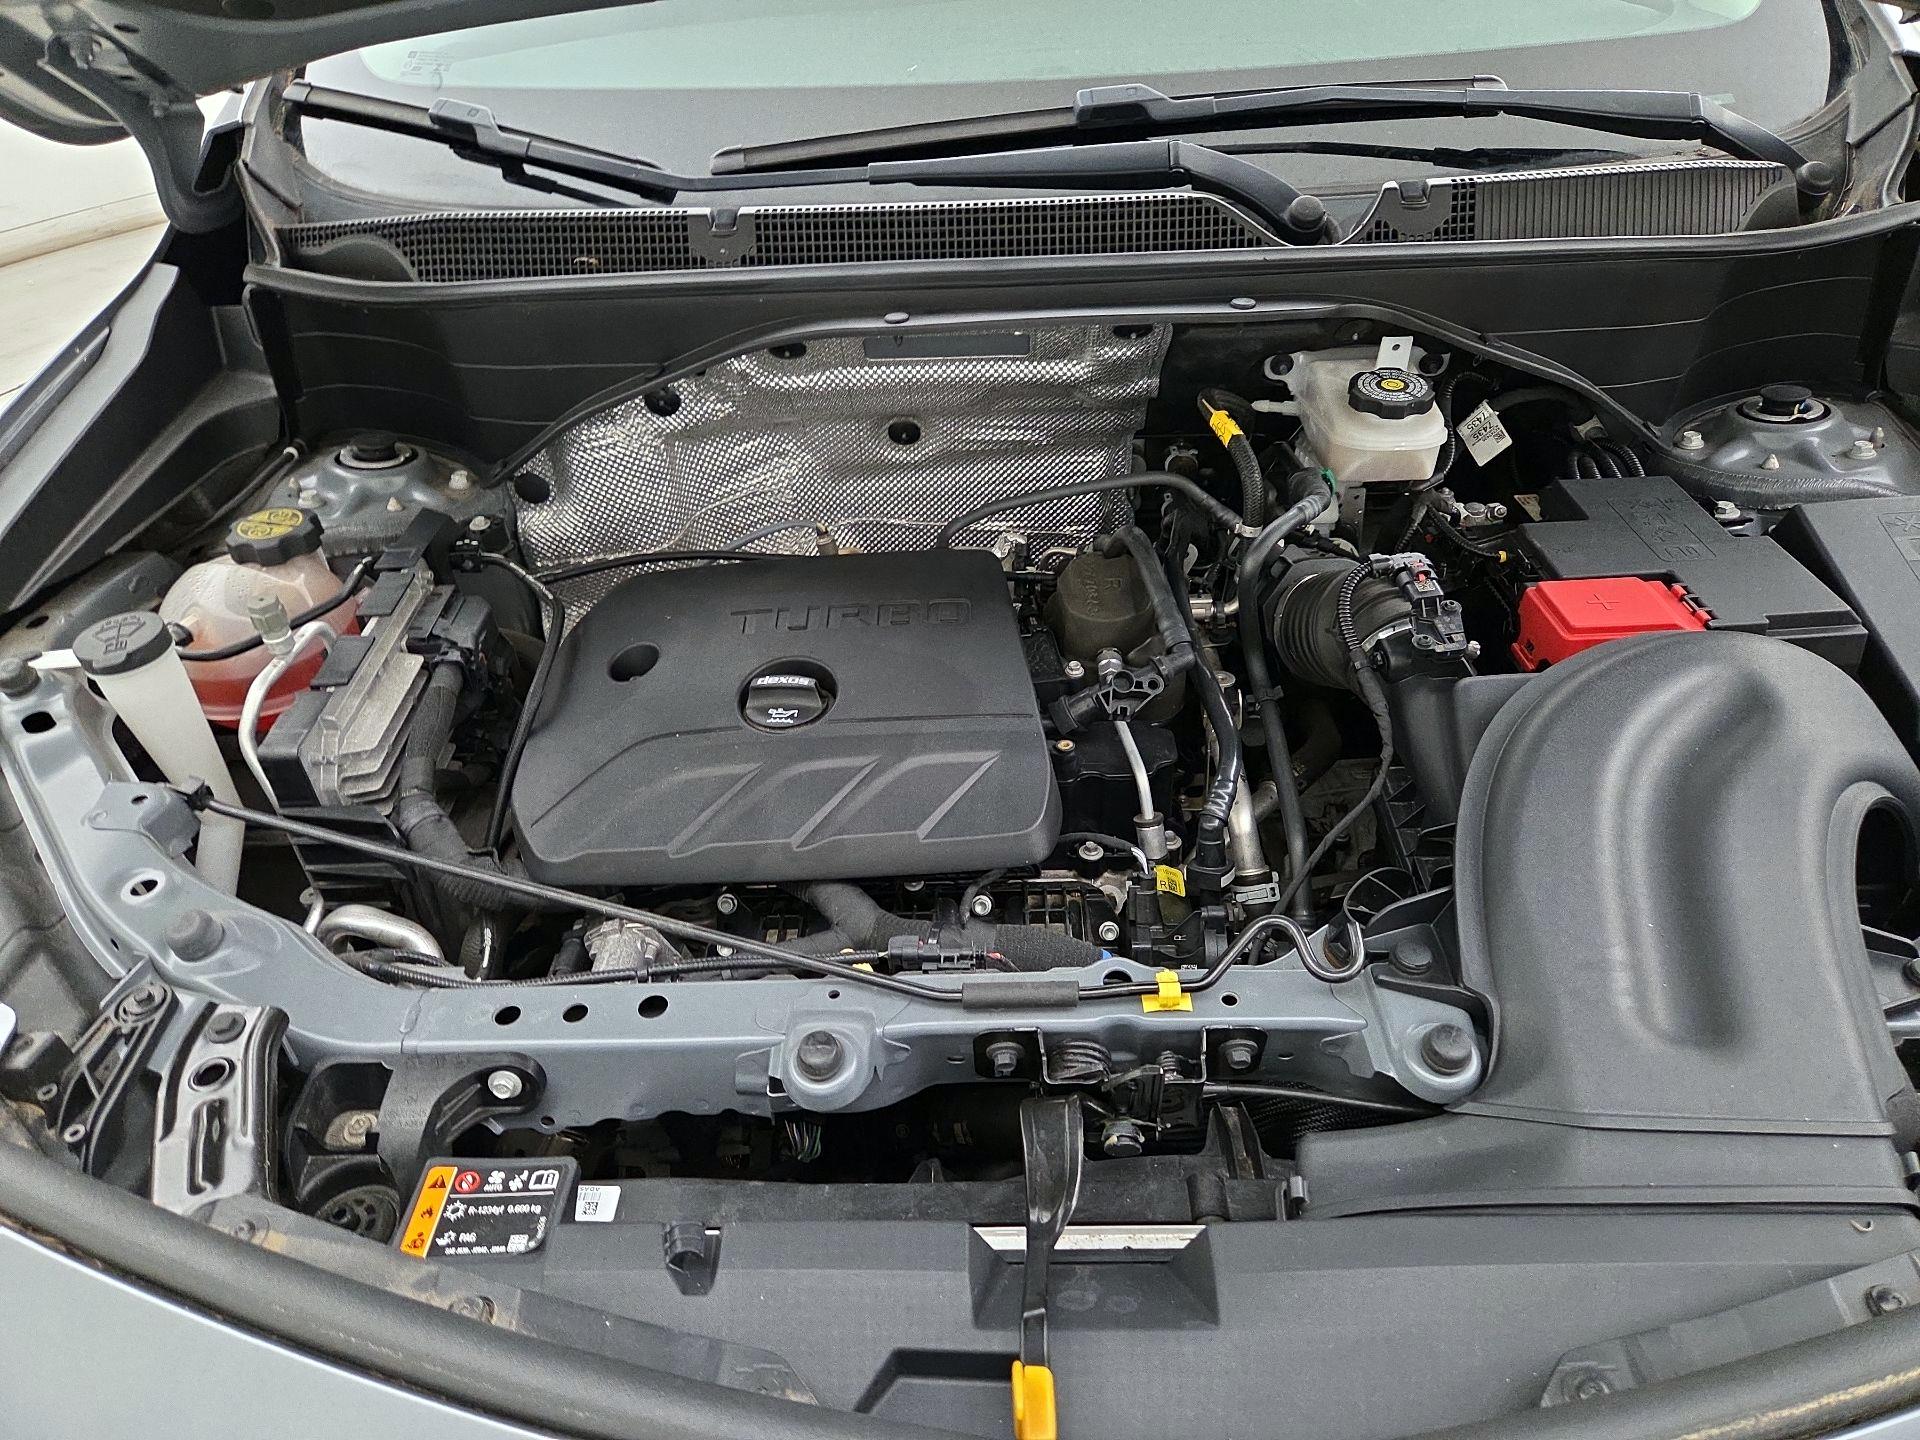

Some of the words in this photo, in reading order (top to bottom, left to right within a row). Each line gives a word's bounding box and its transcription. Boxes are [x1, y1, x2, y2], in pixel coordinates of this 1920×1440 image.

[730, 598, 972, 634] TURBO
[757, 675, 810, 686] dexos
[1159, 880, 1168, 889] R
